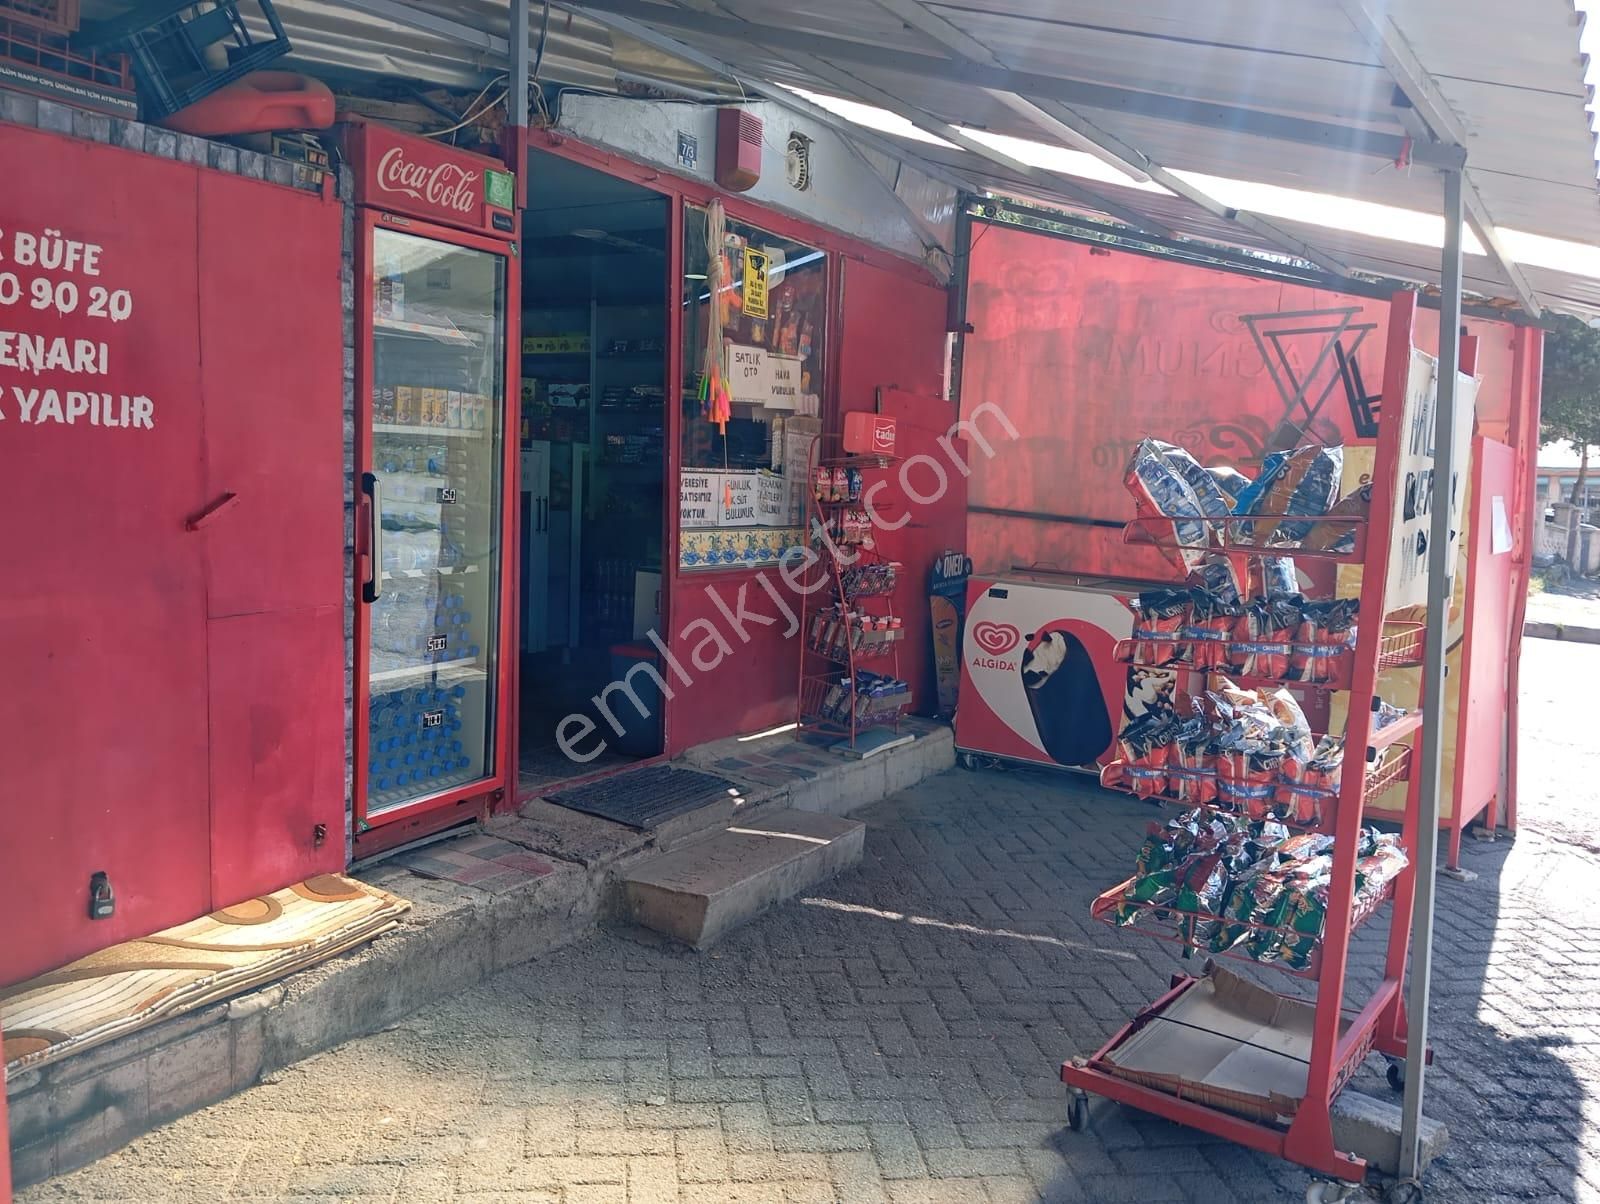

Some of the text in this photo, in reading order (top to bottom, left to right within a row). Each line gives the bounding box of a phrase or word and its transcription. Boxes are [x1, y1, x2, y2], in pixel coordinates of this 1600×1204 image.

[14, 228, 104, 276] BÜFE
[30, 277, 79, 316] 90
[87, 286, 133, 322] 20
[744, 366, 758, 378] OTO
[775, 369, 790, 381] HAVA
[11, 386, 154, 430] YAPILIR
[725, 507, 755, 521] BULUNUR
